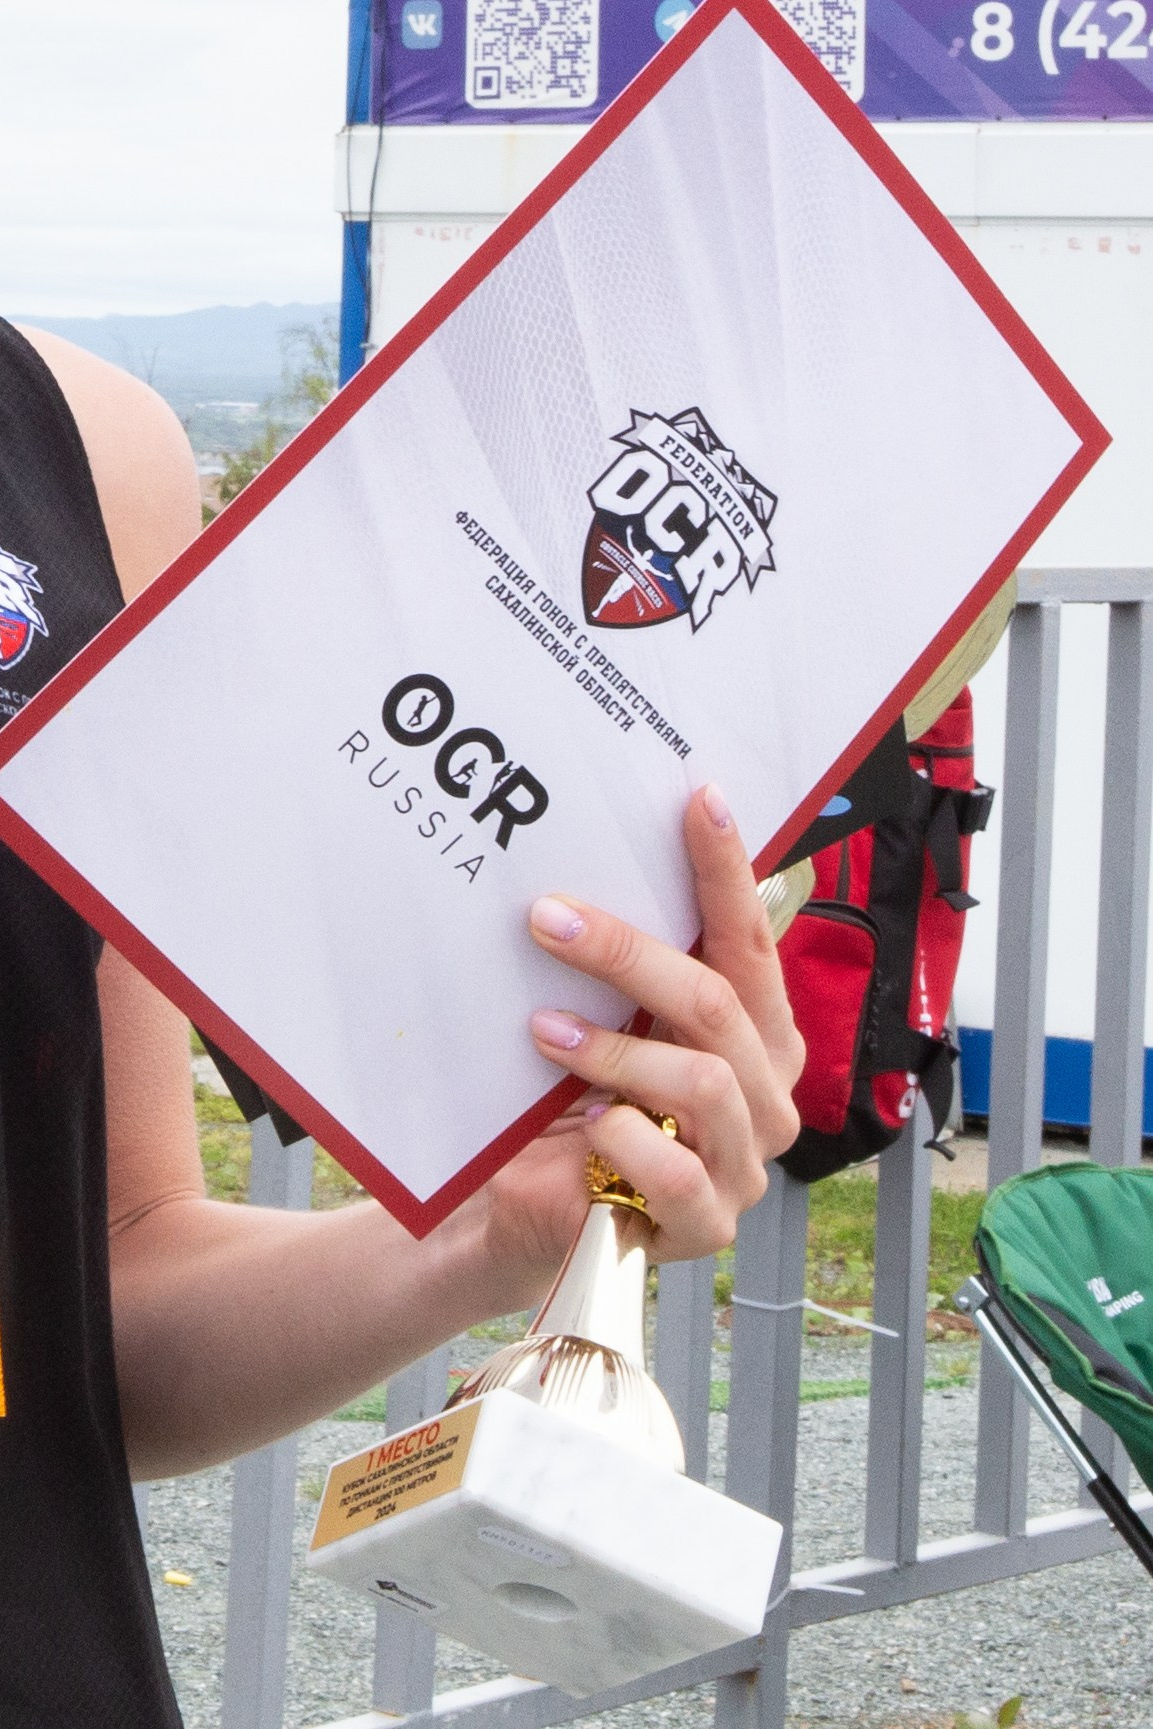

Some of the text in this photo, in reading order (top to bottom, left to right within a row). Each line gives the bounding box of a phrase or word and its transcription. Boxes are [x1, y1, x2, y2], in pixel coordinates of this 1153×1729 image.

[971, 1, 1014, 61] 8
[588, 448, 743, 633] OCR
[658, 434, 755, 541] FEDERATION
[454, 509, 693, 761] ФЕДЕРАЦИЯ ГОНОК С ПРЕПЯТСТВИЯМИ
[484, 574, 638, 733] САХАЛИНСКОЙ ОБЛАСТИ
[337, 729, 485, 884] RUSSIA
[381, 673, 549, 851] OCR
[376, 1421, 441, 1468] МЕСТО
